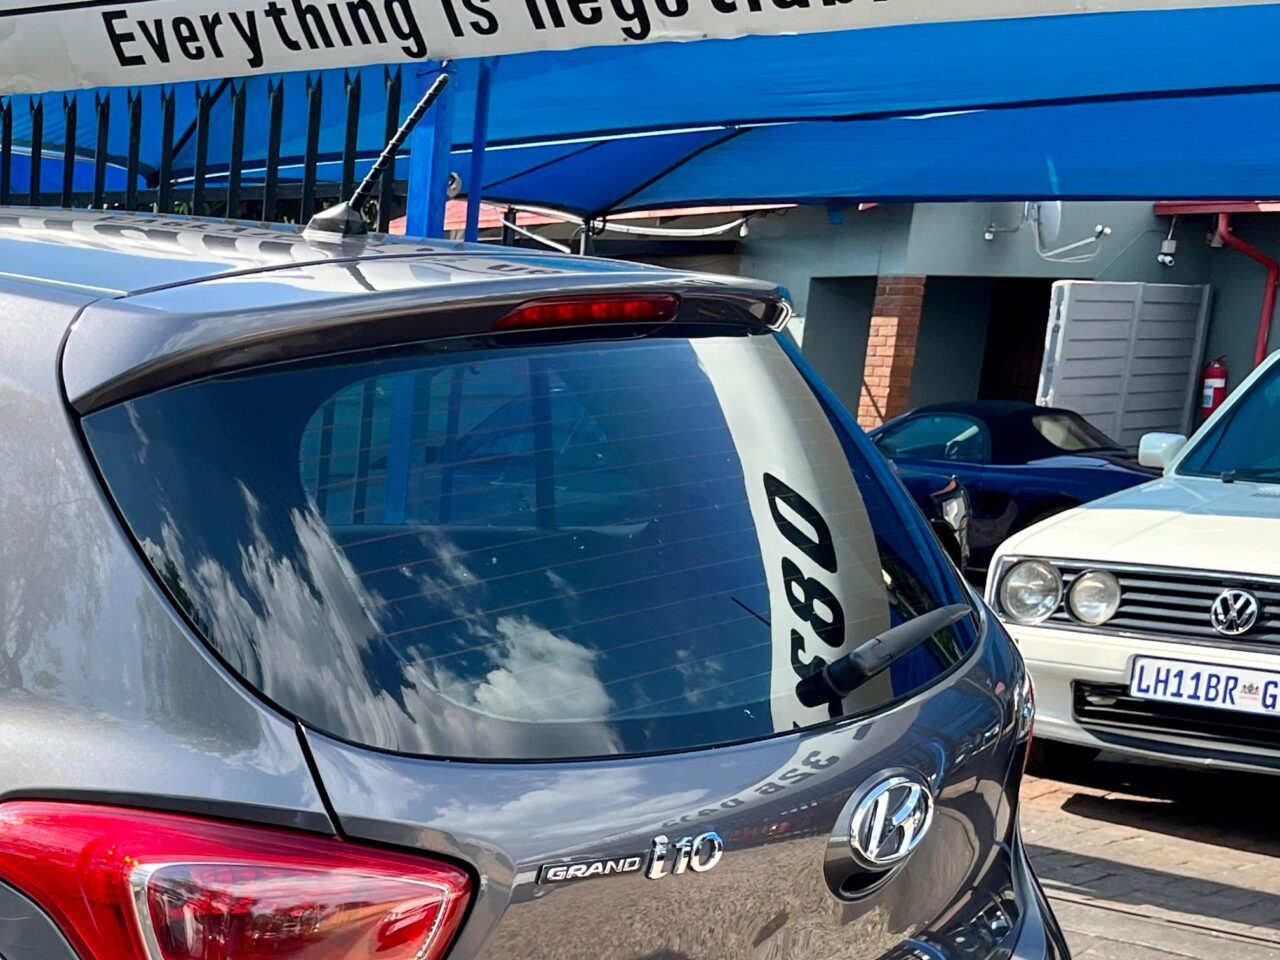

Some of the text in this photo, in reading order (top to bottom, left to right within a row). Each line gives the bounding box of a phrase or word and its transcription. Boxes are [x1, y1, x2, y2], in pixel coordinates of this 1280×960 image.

[101, 0, 428, 68] Everything
[546, 831, 724, 881] GRAND i10
